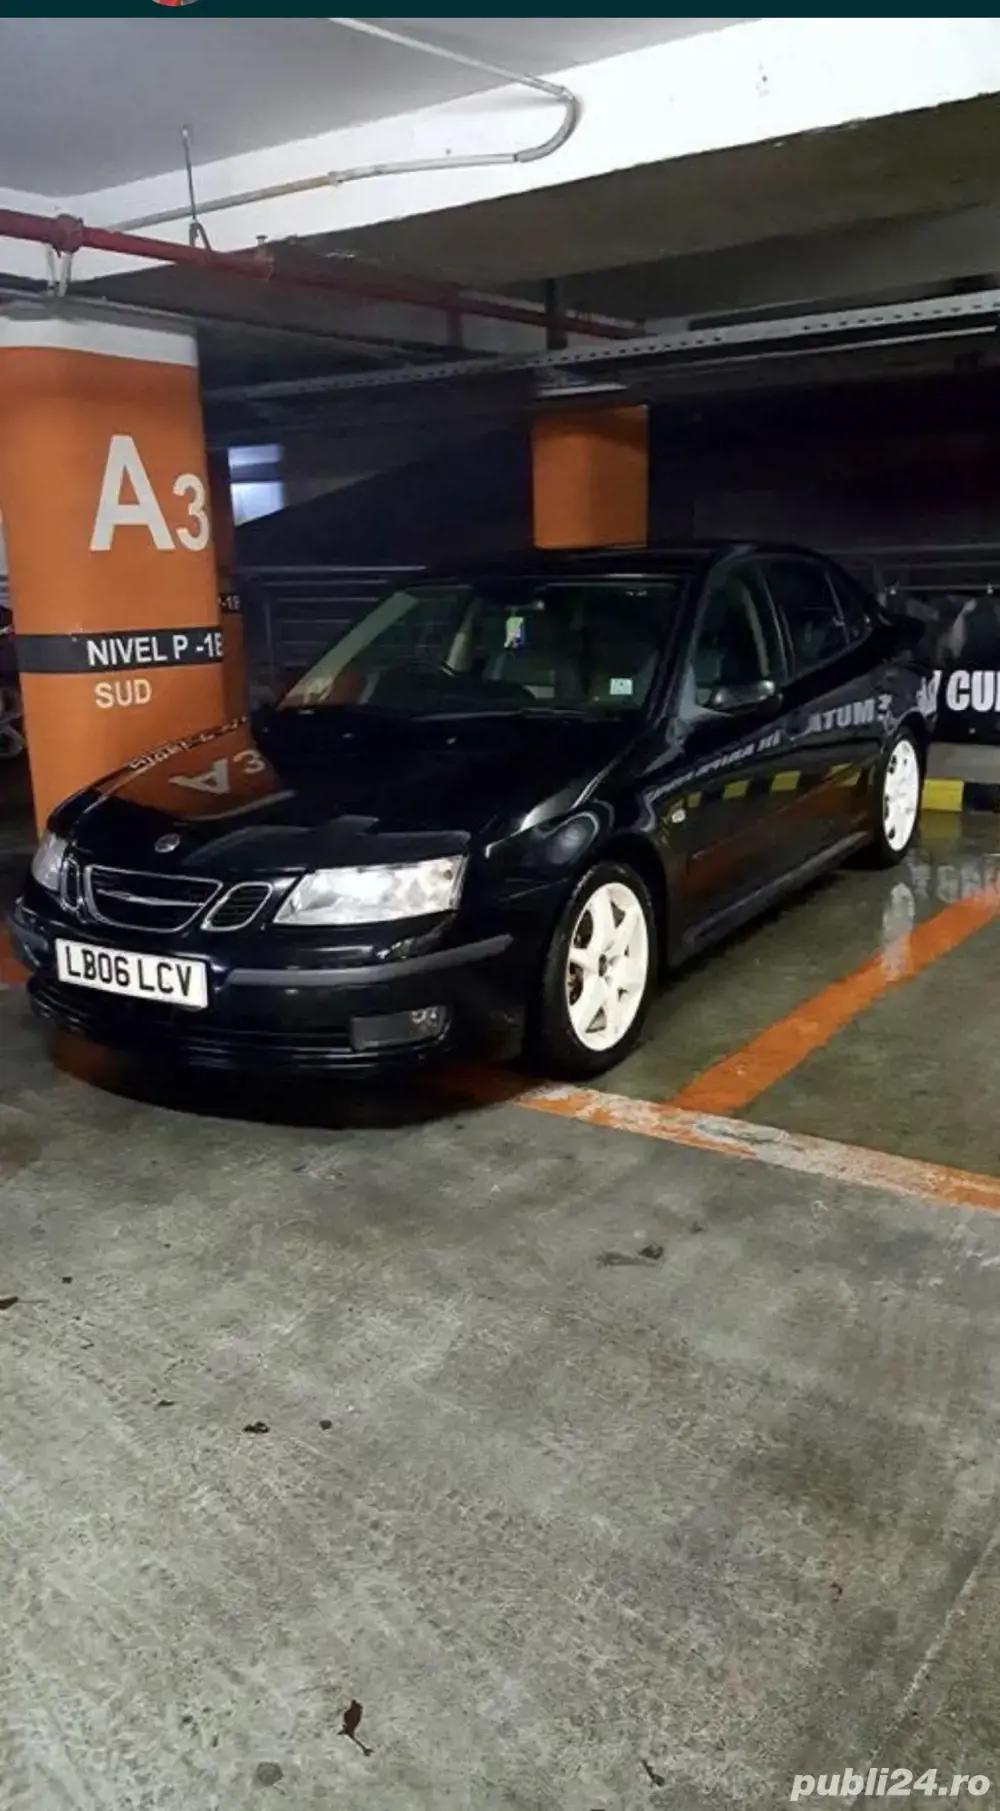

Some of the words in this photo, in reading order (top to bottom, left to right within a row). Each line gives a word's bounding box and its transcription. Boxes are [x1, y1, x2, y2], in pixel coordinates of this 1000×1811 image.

[86, 636, 168, 666] NIVEL
[172, 634, 189, 660] P
[94, 678, 152, 709] SUD
[66, 946, 131, 987] LB06
[138, 958, 192, 997] LCV
